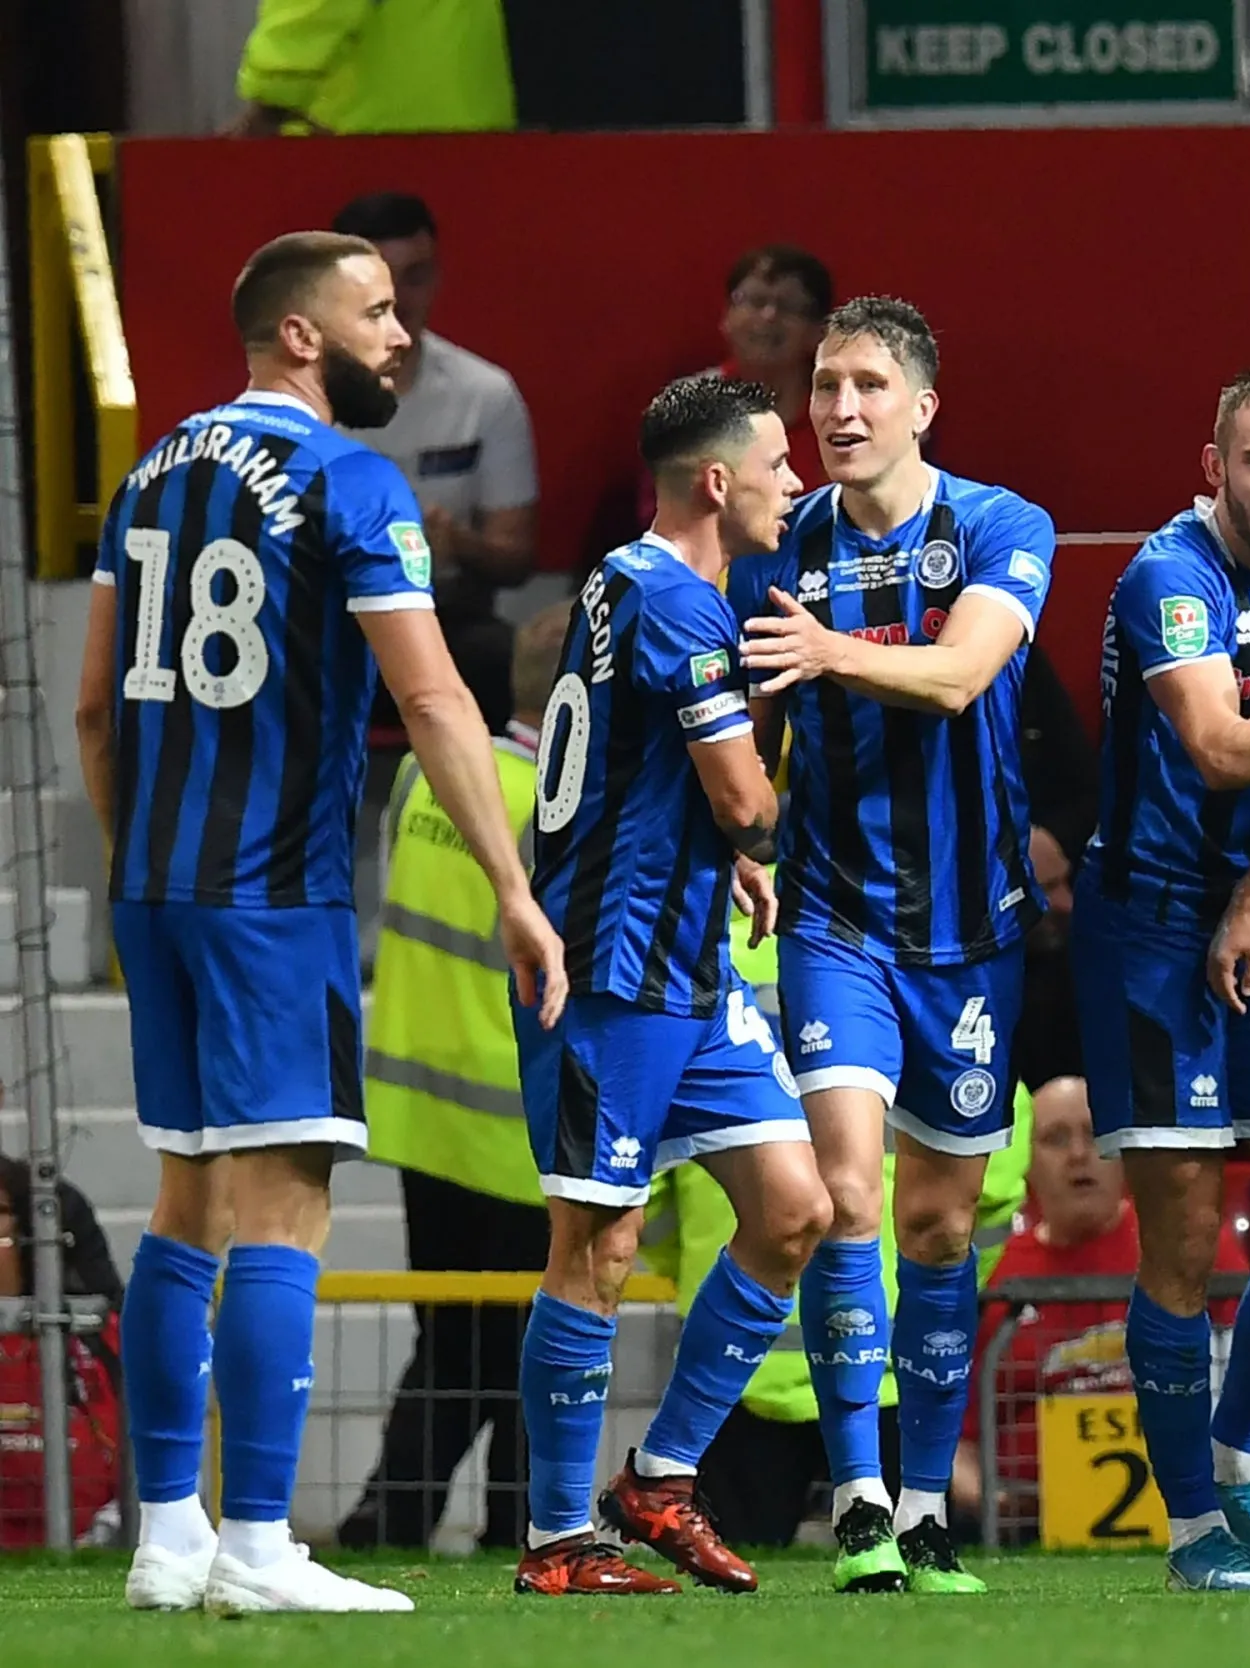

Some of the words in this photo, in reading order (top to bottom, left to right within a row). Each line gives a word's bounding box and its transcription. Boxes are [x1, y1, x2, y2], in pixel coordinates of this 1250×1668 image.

[876, 23, 1007, 75] KEEP
[1022, 21, 1219, 74] CLOSED
[126, 424, 305, 537] WILBRAHAM
[124, 527, 269, 709] 18
[951, 996, 996, 1065] 4
[1090, 1449, 1150, 1538] 2
